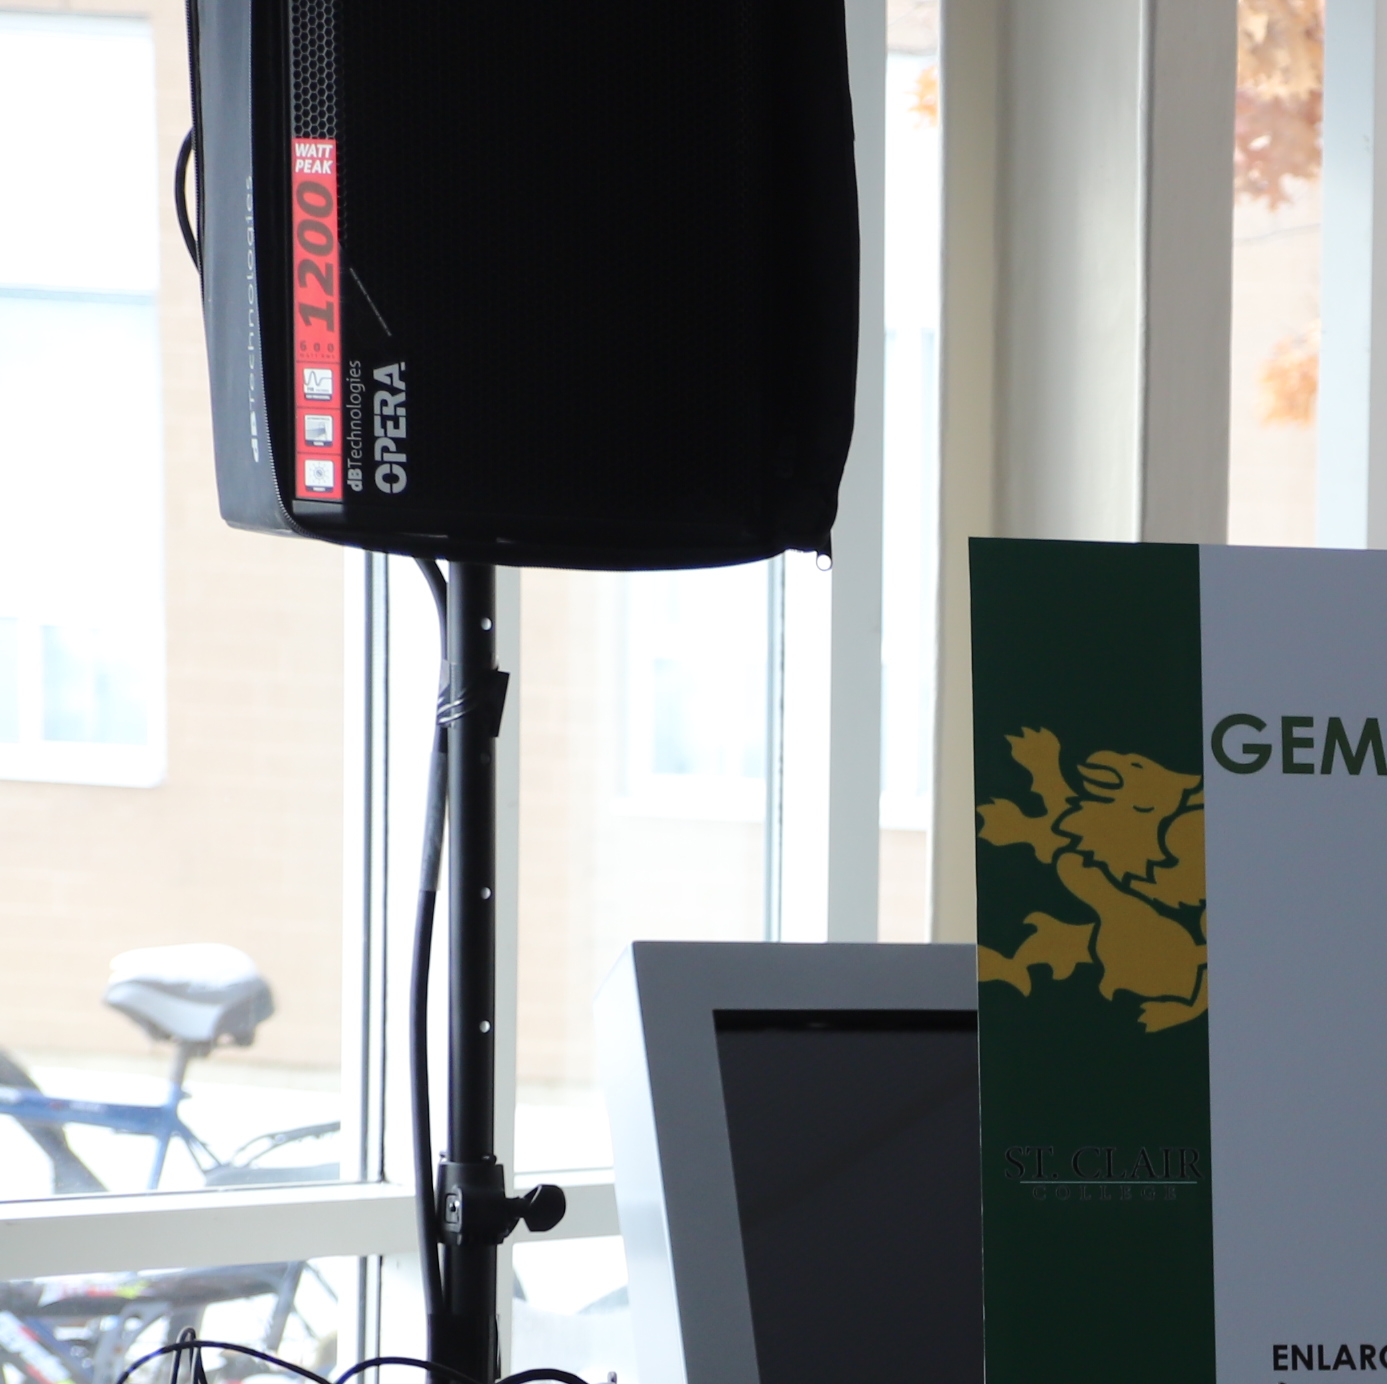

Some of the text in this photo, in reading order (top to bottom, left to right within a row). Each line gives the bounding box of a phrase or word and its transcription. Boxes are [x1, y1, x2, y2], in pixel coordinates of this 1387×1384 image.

[295, 143, 333, 158] WATT
[295, 159, 333, 174] PEAK
[296, 180, 335, 332] 1200
[346, 360, 366, 492] dBTechnologies
[373, 361, 407, 494] OPERA
[1004, 1146, 1203, 1179] ST. CLAIR
[1032, 1185, 1177, 1200] COLLEGE
